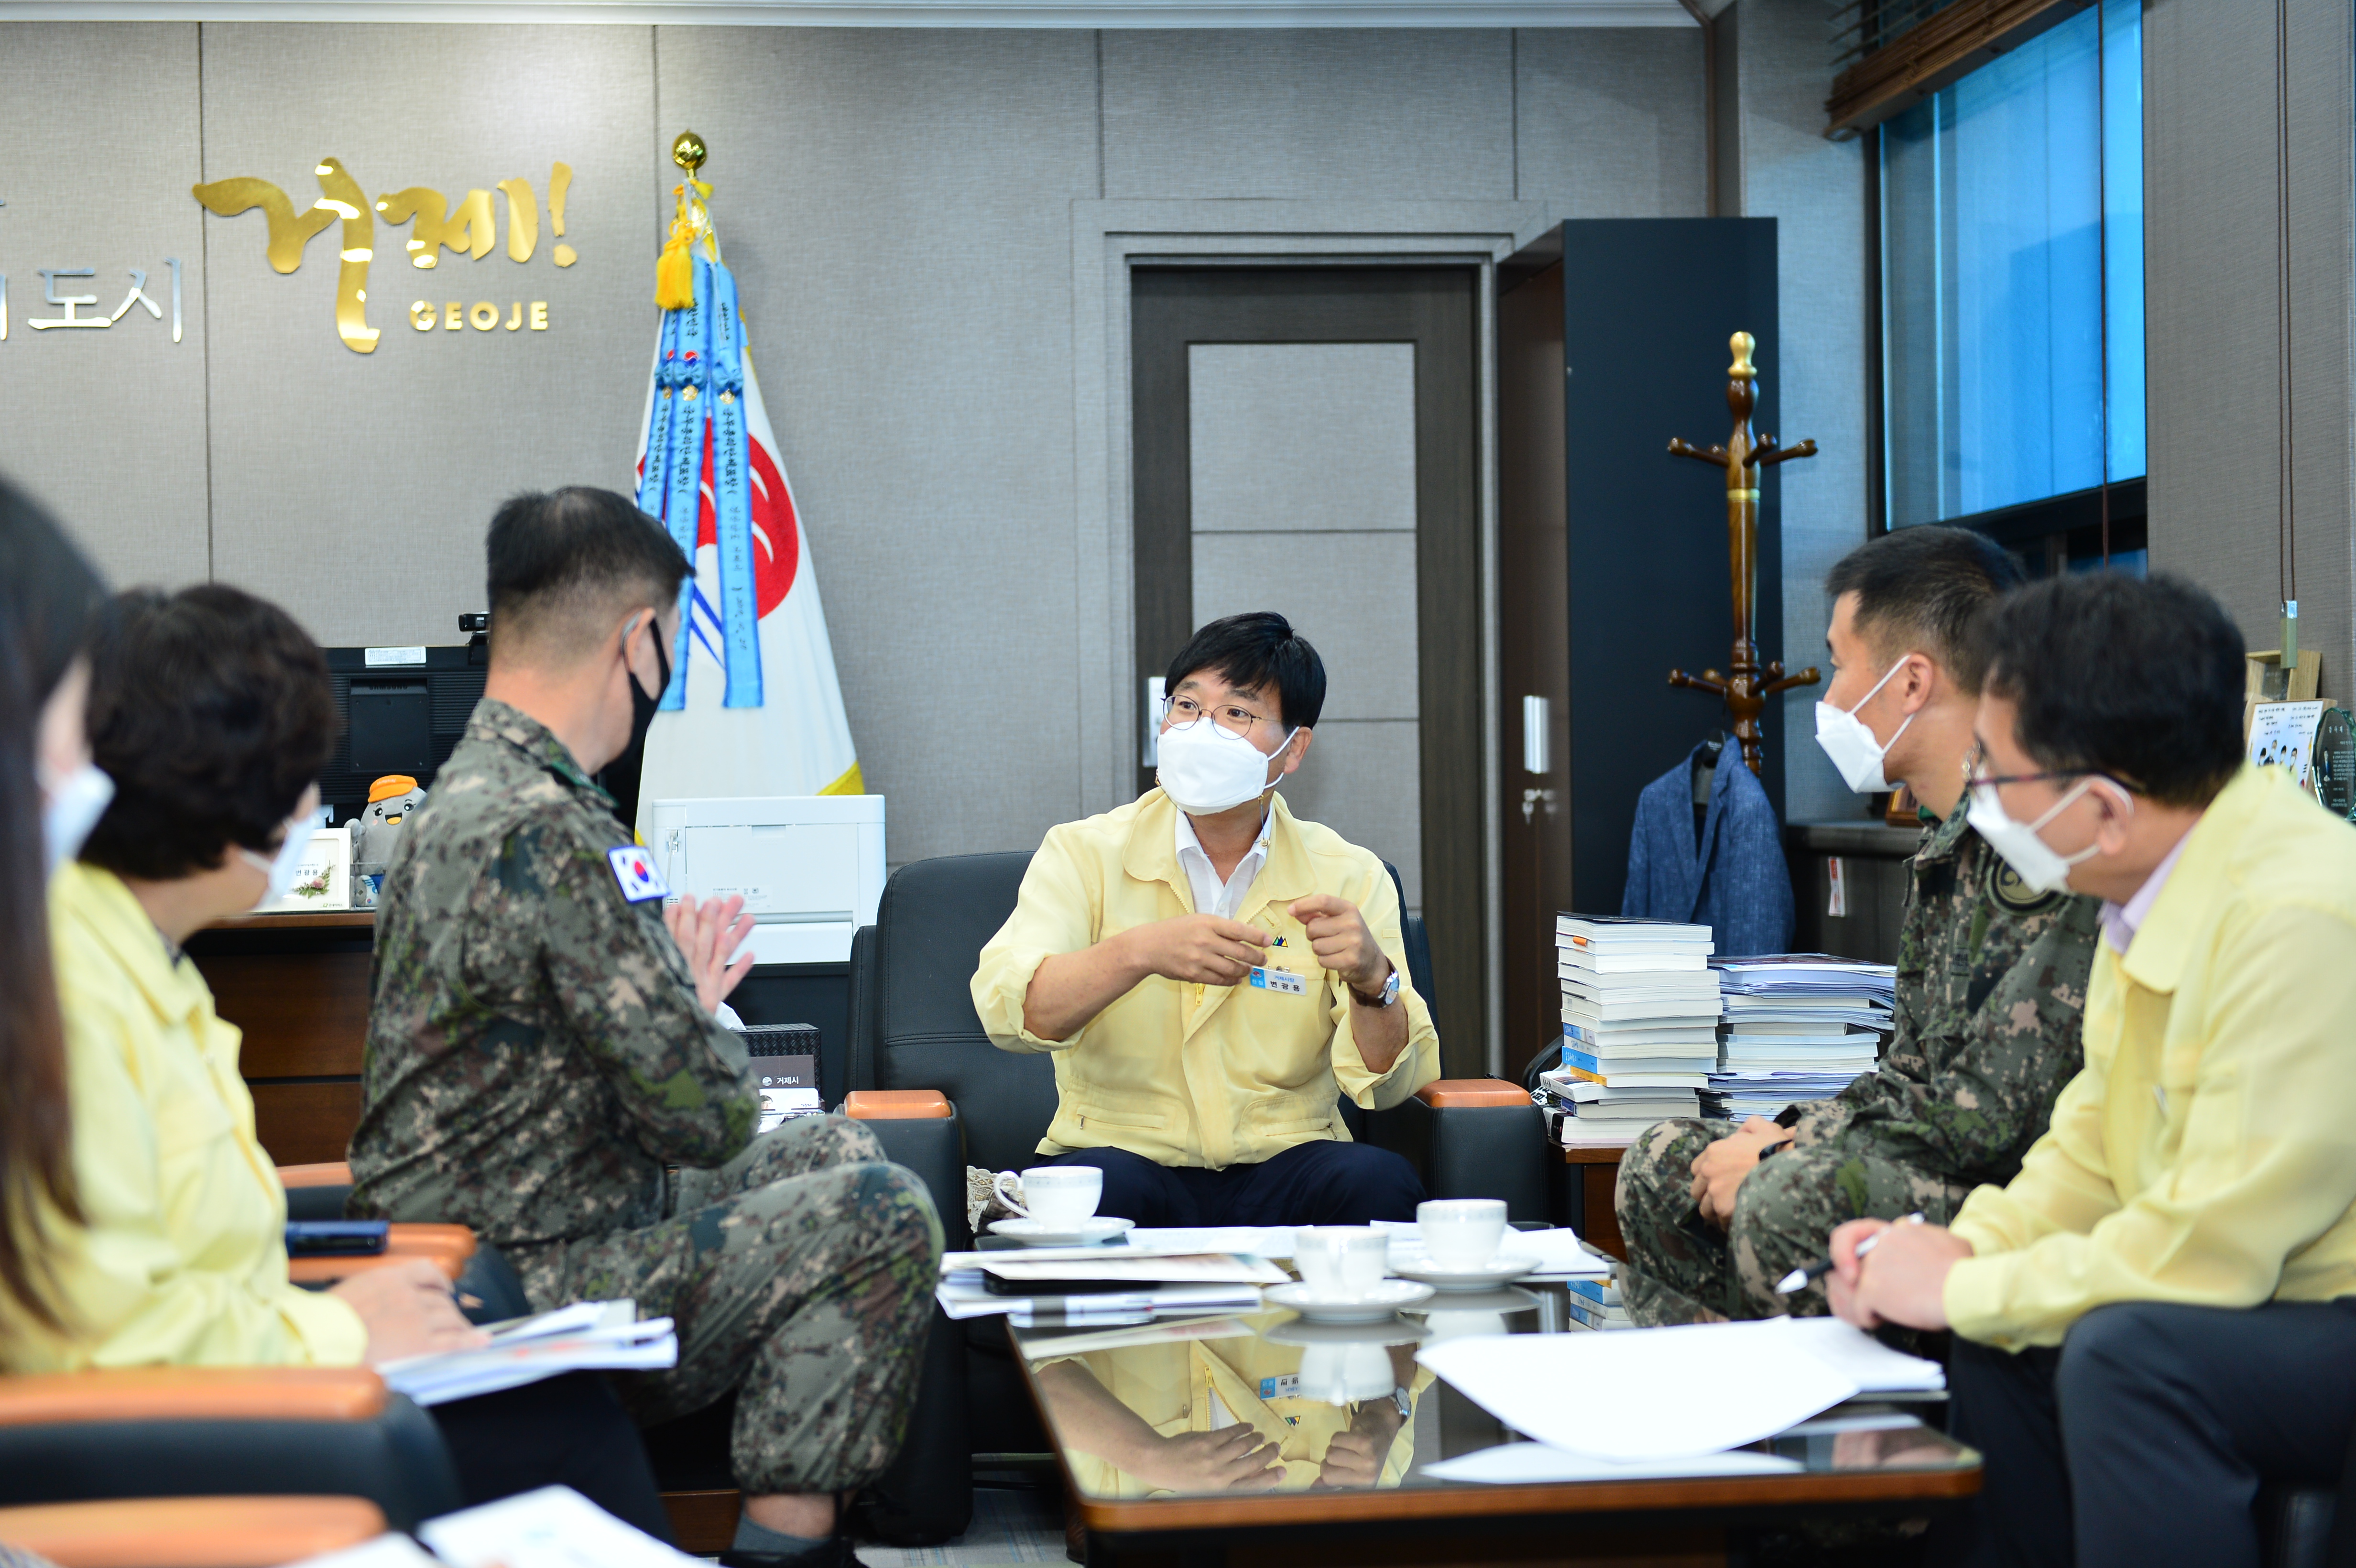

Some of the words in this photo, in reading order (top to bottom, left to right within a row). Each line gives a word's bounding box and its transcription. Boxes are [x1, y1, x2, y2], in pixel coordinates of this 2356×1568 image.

[28, 257, 182, 343] 도시
[409, 300, 549, 330] GEOJE
[777, 1077, 799, 1085] 거제시
